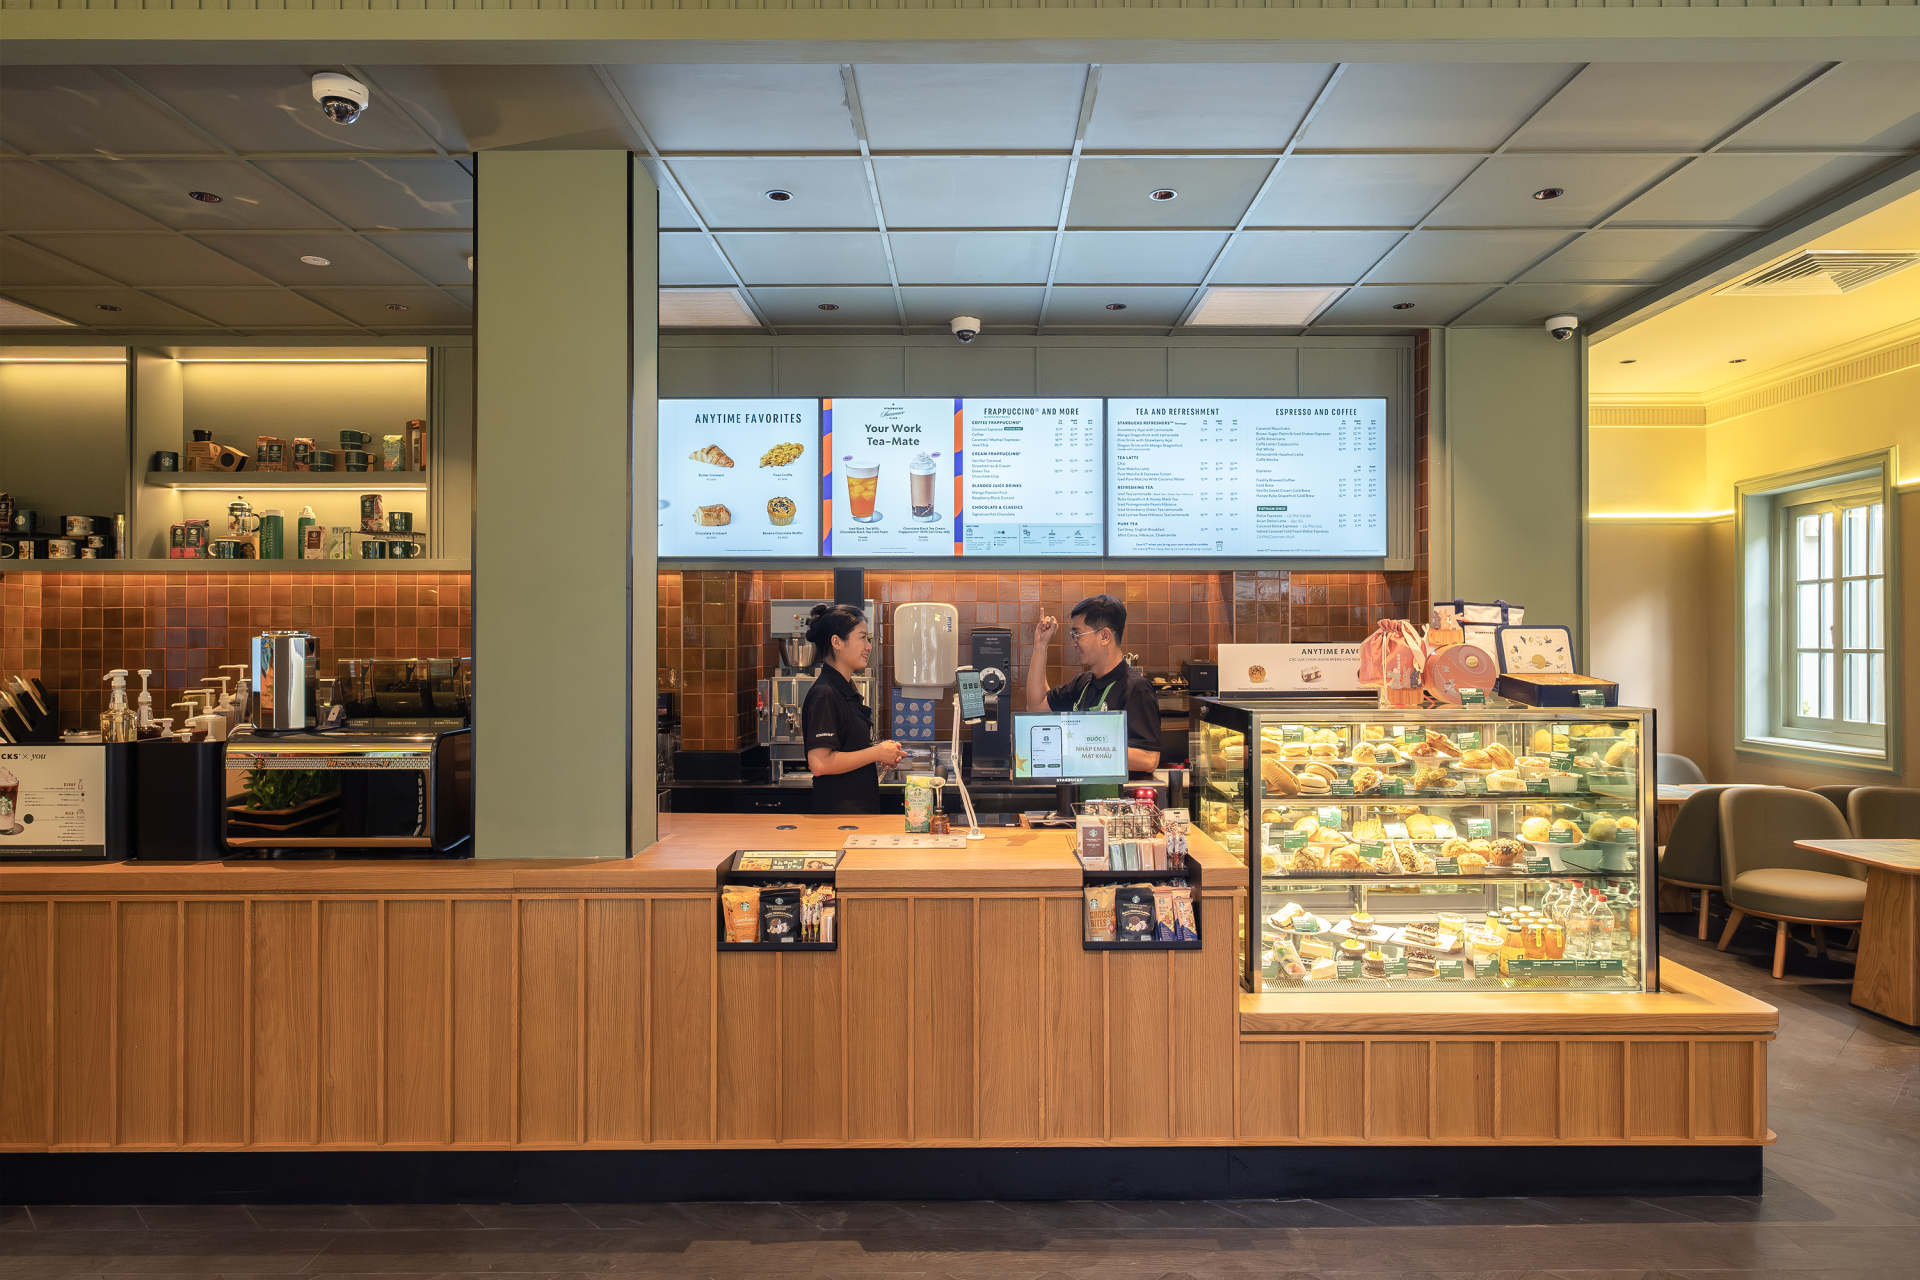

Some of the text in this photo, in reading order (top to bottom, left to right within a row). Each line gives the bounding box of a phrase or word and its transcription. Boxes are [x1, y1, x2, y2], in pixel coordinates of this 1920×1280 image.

[1041, 407, 1057, 416] AND
[1059, 407, 1079, 416] MORE
[1136, 408, 1219, 416] TEA AND REFRESHMENT
[1275, 408, 1357, 416] ESPRESSO AND COFFEE
[695, 413, 802, 424] ANYTIME FAVORITES
[865, 424, 922, 433] Your Work
[867, 437, 920, 446] Tea-Mate
[1090, 919, 1107, 928] BITES
